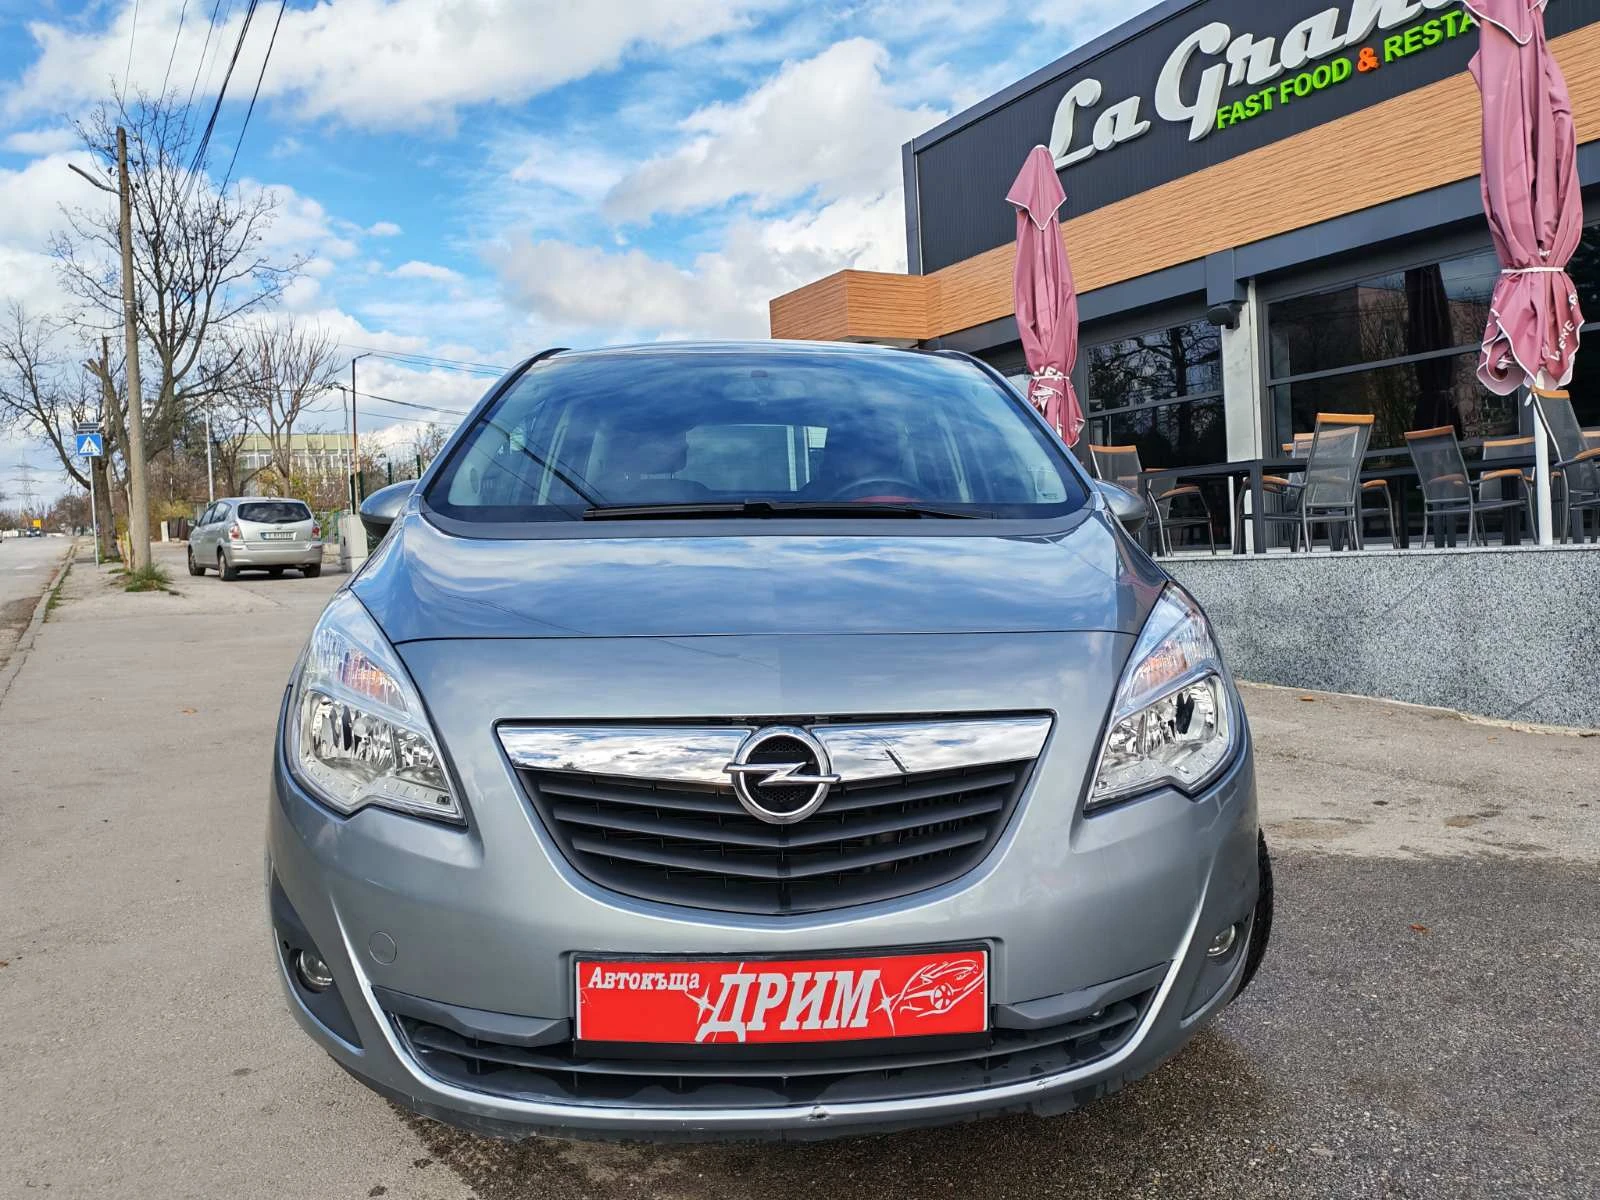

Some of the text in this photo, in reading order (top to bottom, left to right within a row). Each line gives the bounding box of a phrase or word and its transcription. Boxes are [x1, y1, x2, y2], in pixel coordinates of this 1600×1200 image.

[1049, 78, 1151, 170] La
[1217, 86, 1277, 129] FAST
[1280, 57, 1352, 105] FOOD
[1357, 47, 1381, 72] &
[587, 966, 700, 993] Автокъща
[694, 968, 881, 1043] ДРИМ
